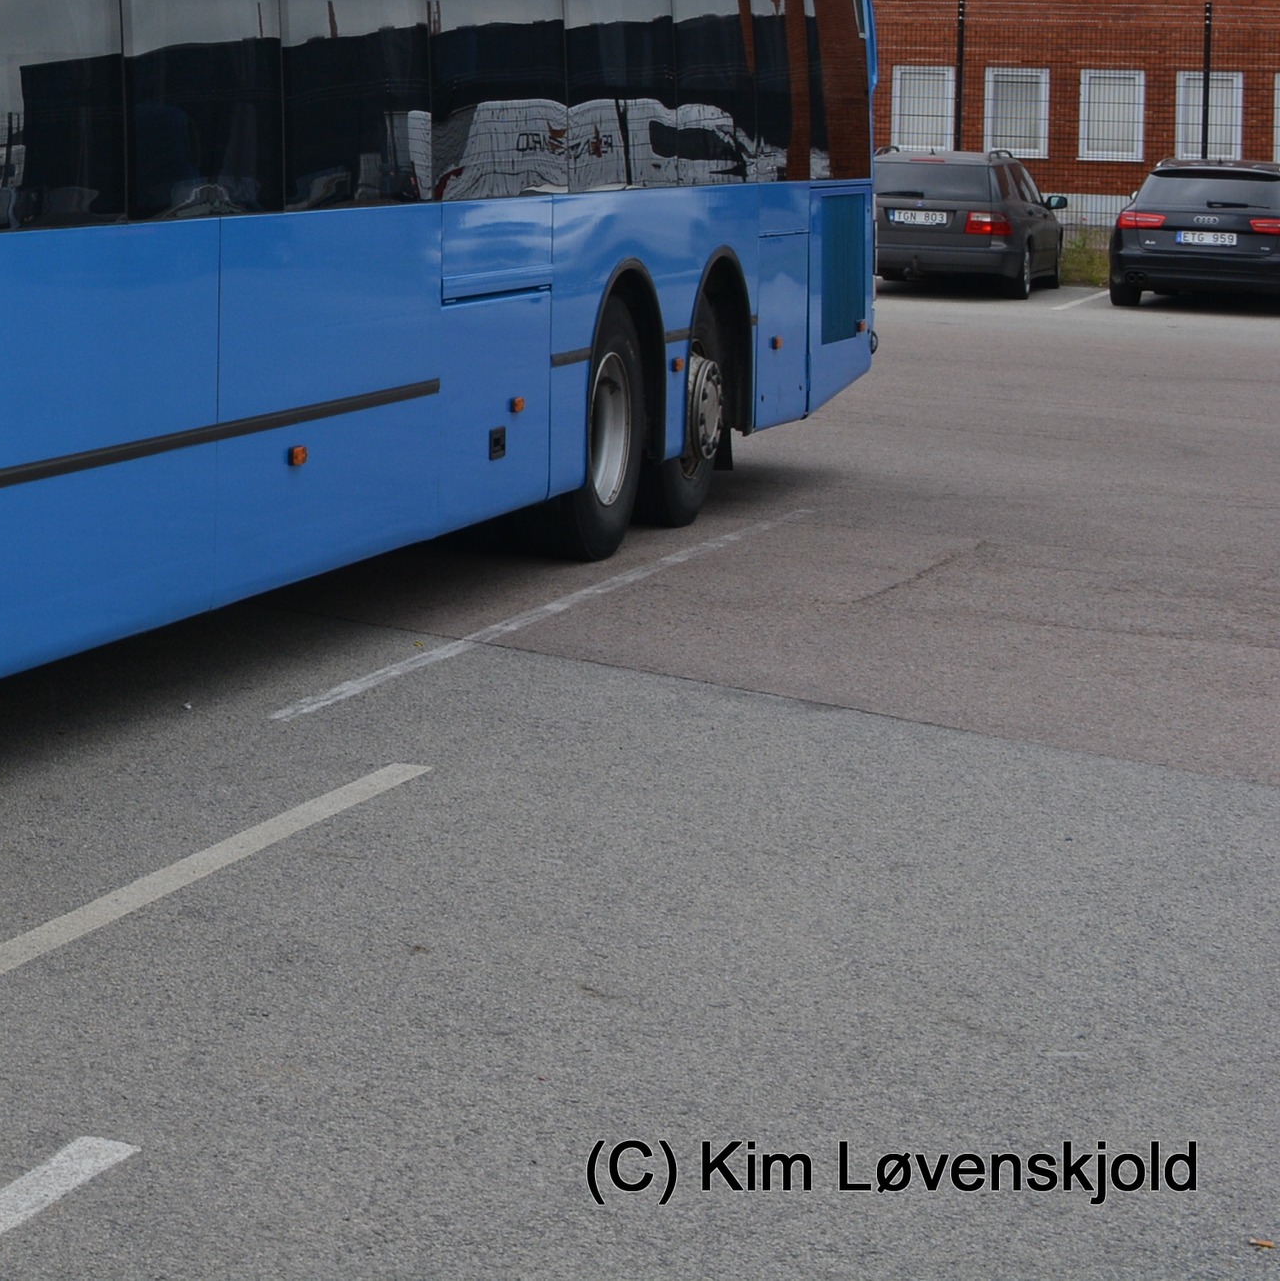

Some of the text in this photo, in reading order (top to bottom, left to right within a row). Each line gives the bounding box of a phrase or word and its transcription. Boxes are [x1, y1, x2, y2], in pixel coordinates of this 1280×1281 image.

[896, 211, 945, 222] TGN 803
[1182, 232, 1235, 244] ETG 959
